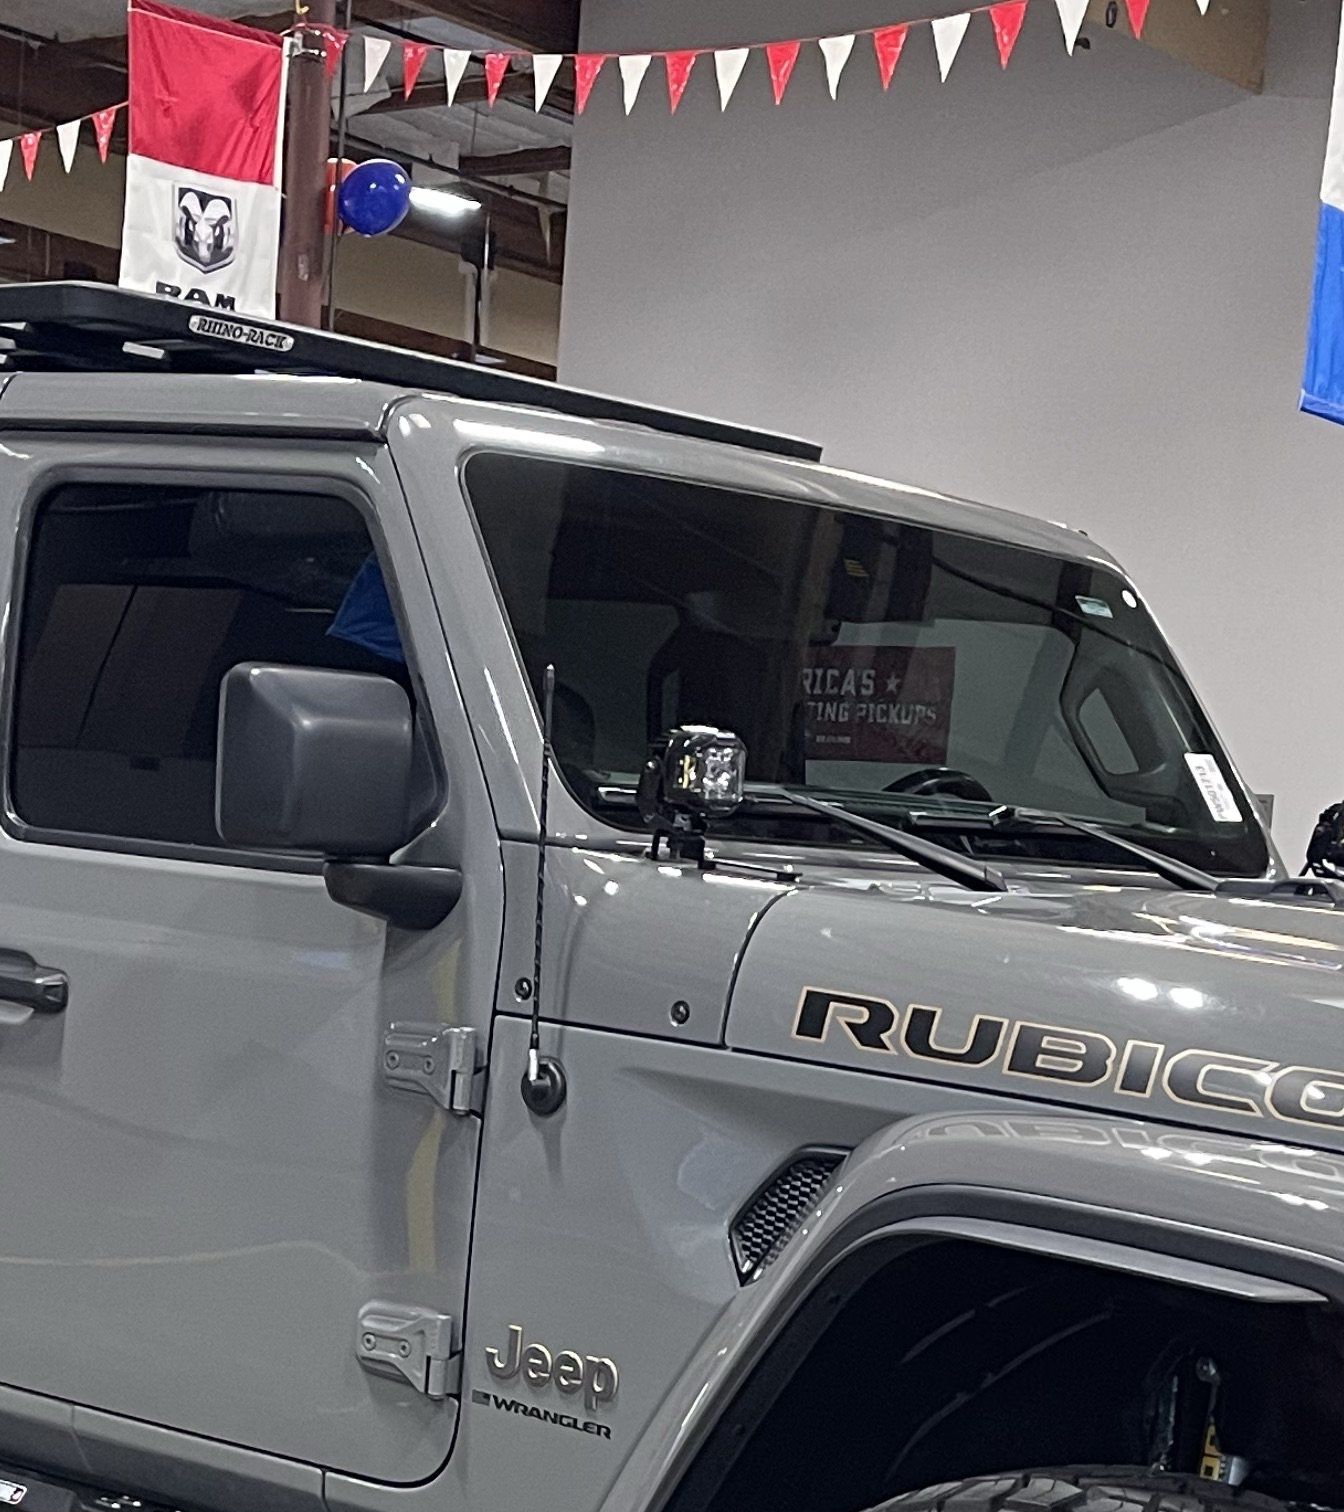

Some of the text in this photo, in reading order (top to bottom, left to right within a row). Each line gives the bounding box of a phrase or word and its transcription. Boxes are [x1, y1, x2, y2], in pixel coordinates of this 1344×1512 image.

[156, 281, 236, 311] RAM
[197, 317, 287, 349] RHINO-RACK
[485, 1324, 619, 1411] Jeep
[492, 1394, 611, 1440] WRANGLER
